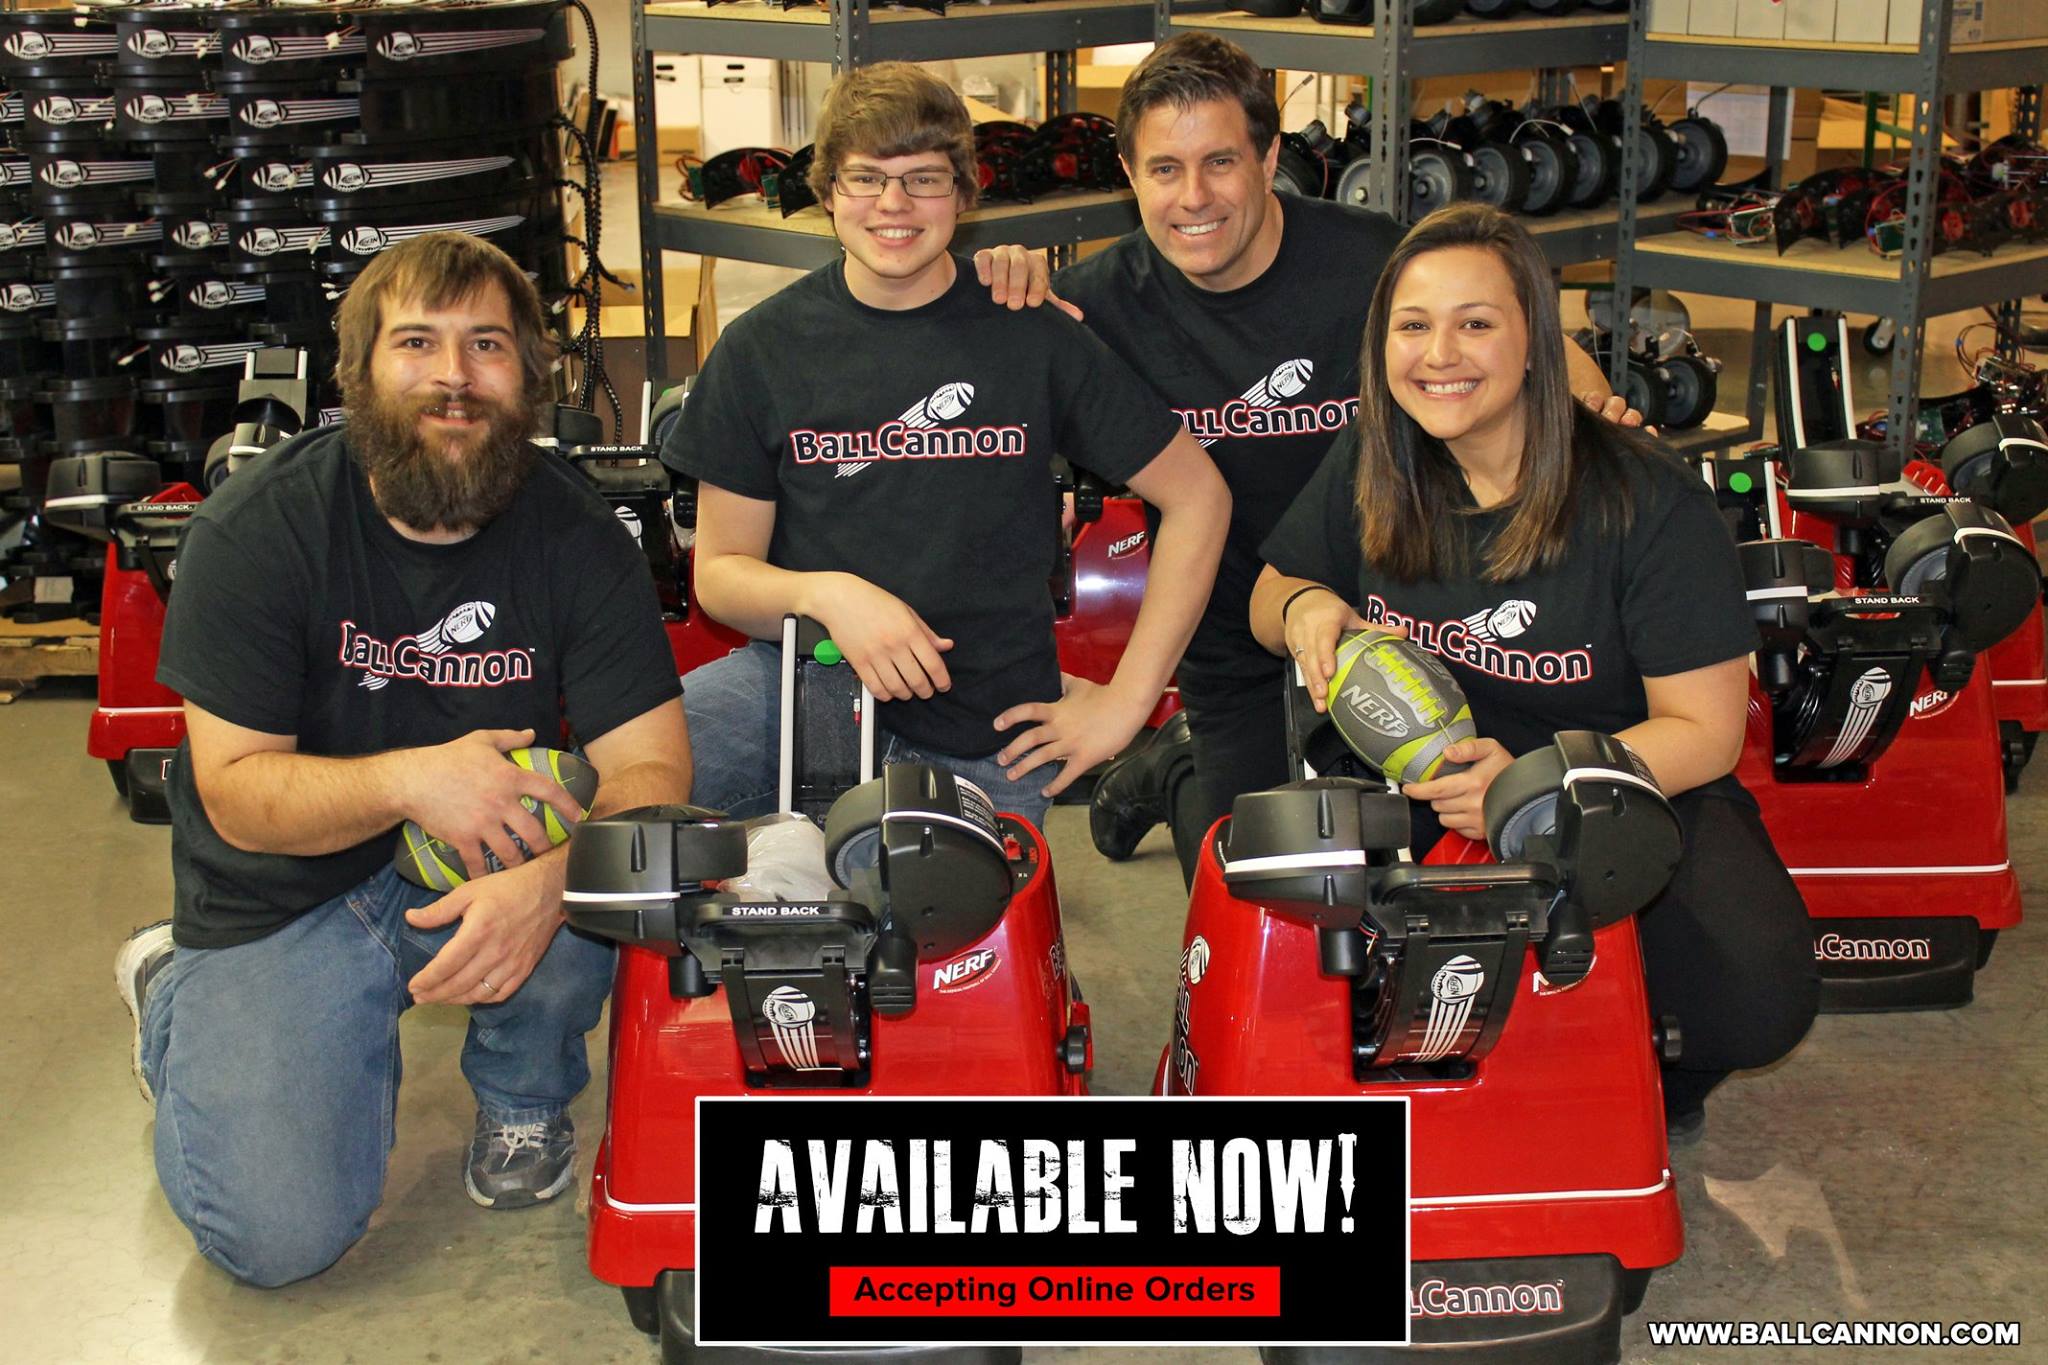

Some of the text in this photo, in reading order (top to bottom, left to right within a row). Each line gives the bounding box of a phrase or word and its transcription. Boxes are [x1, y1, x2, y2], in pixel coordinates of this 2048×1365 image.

[1108, 531, 1145, 558] NERF
[1340, 684, 1410, 736] NERF
[1909, 690, 1948, 717] NER
[732, 906, 820, 916] STAND BACK
[933, 948, 994, 990] NERF
